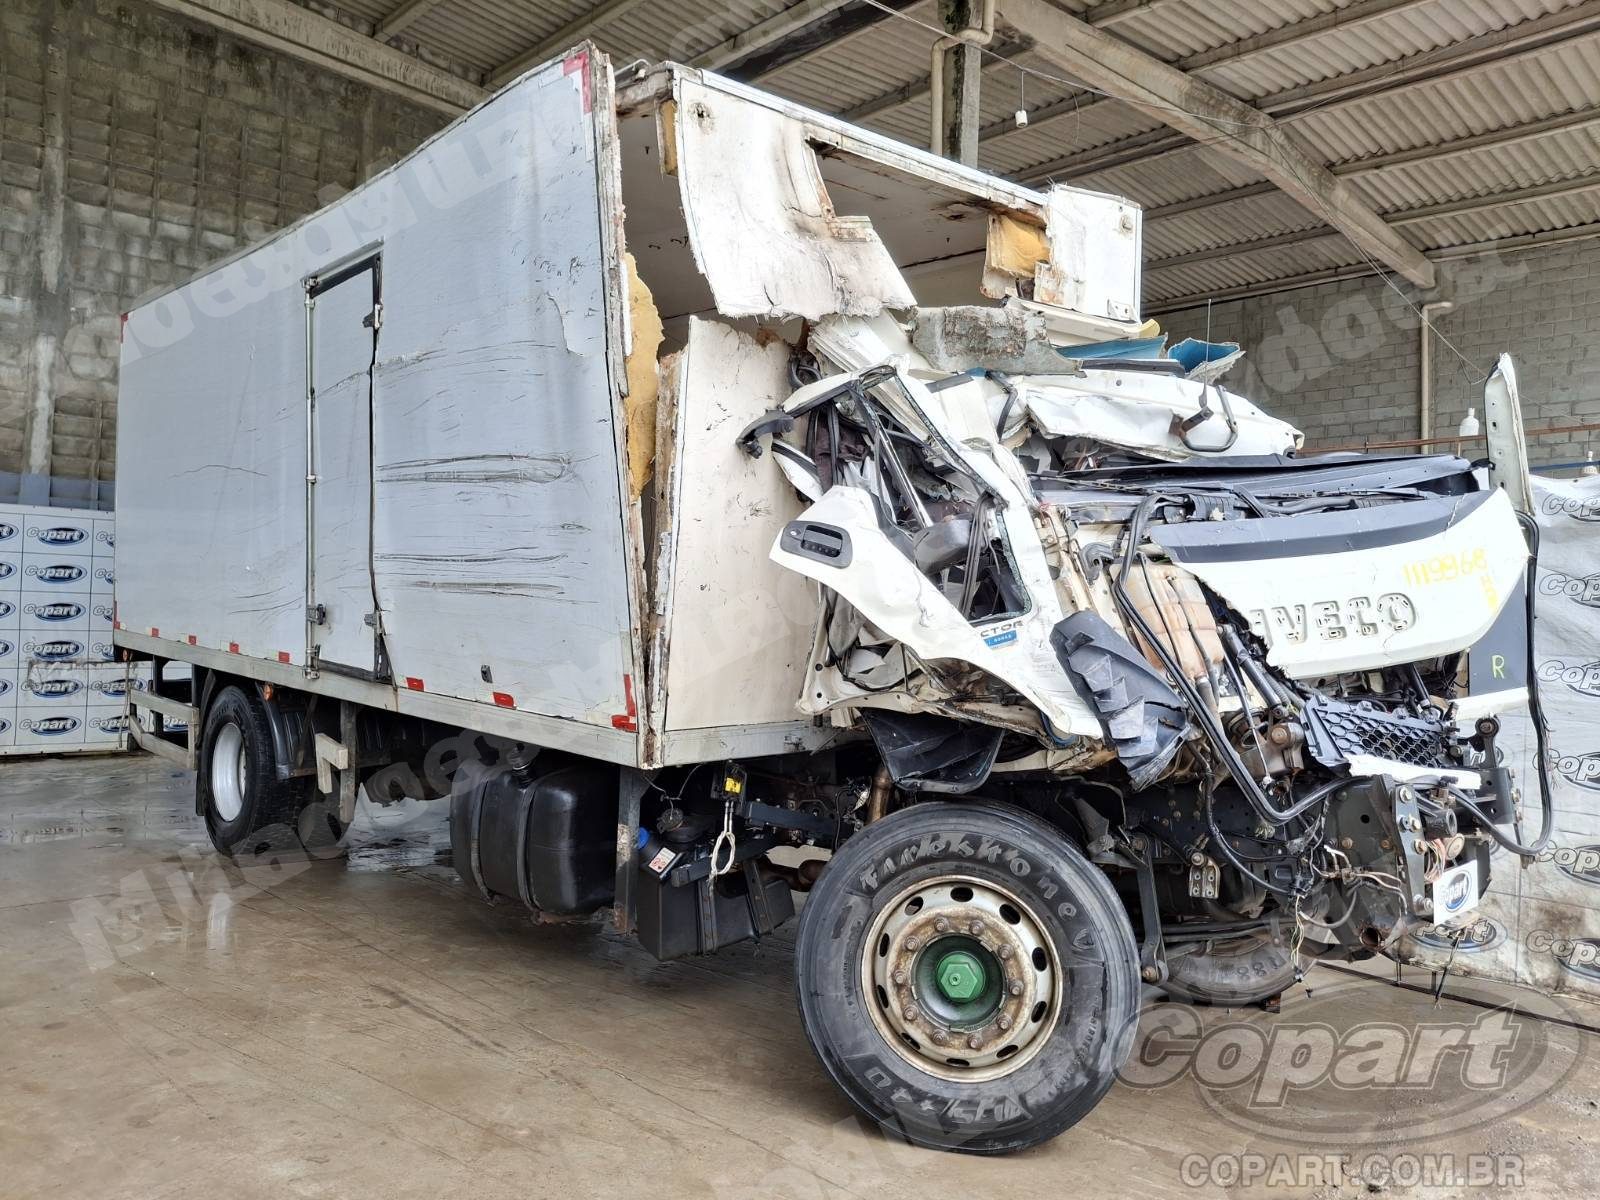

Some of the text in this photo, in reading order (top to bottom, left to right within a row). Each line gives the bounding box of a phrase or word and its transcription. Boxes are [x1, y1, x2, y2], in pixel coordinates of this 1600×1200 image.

[27, 526, 81, 541] Copart
[25, 564, 79, 580] Copart
[23, 602, 78, 618] Copart
[22, 641, 76, 657] Copart
[1491, 655, 1506, 679] R
[21, 679, 75, 695] Copart
[19, 717, 74, 731] Copart
